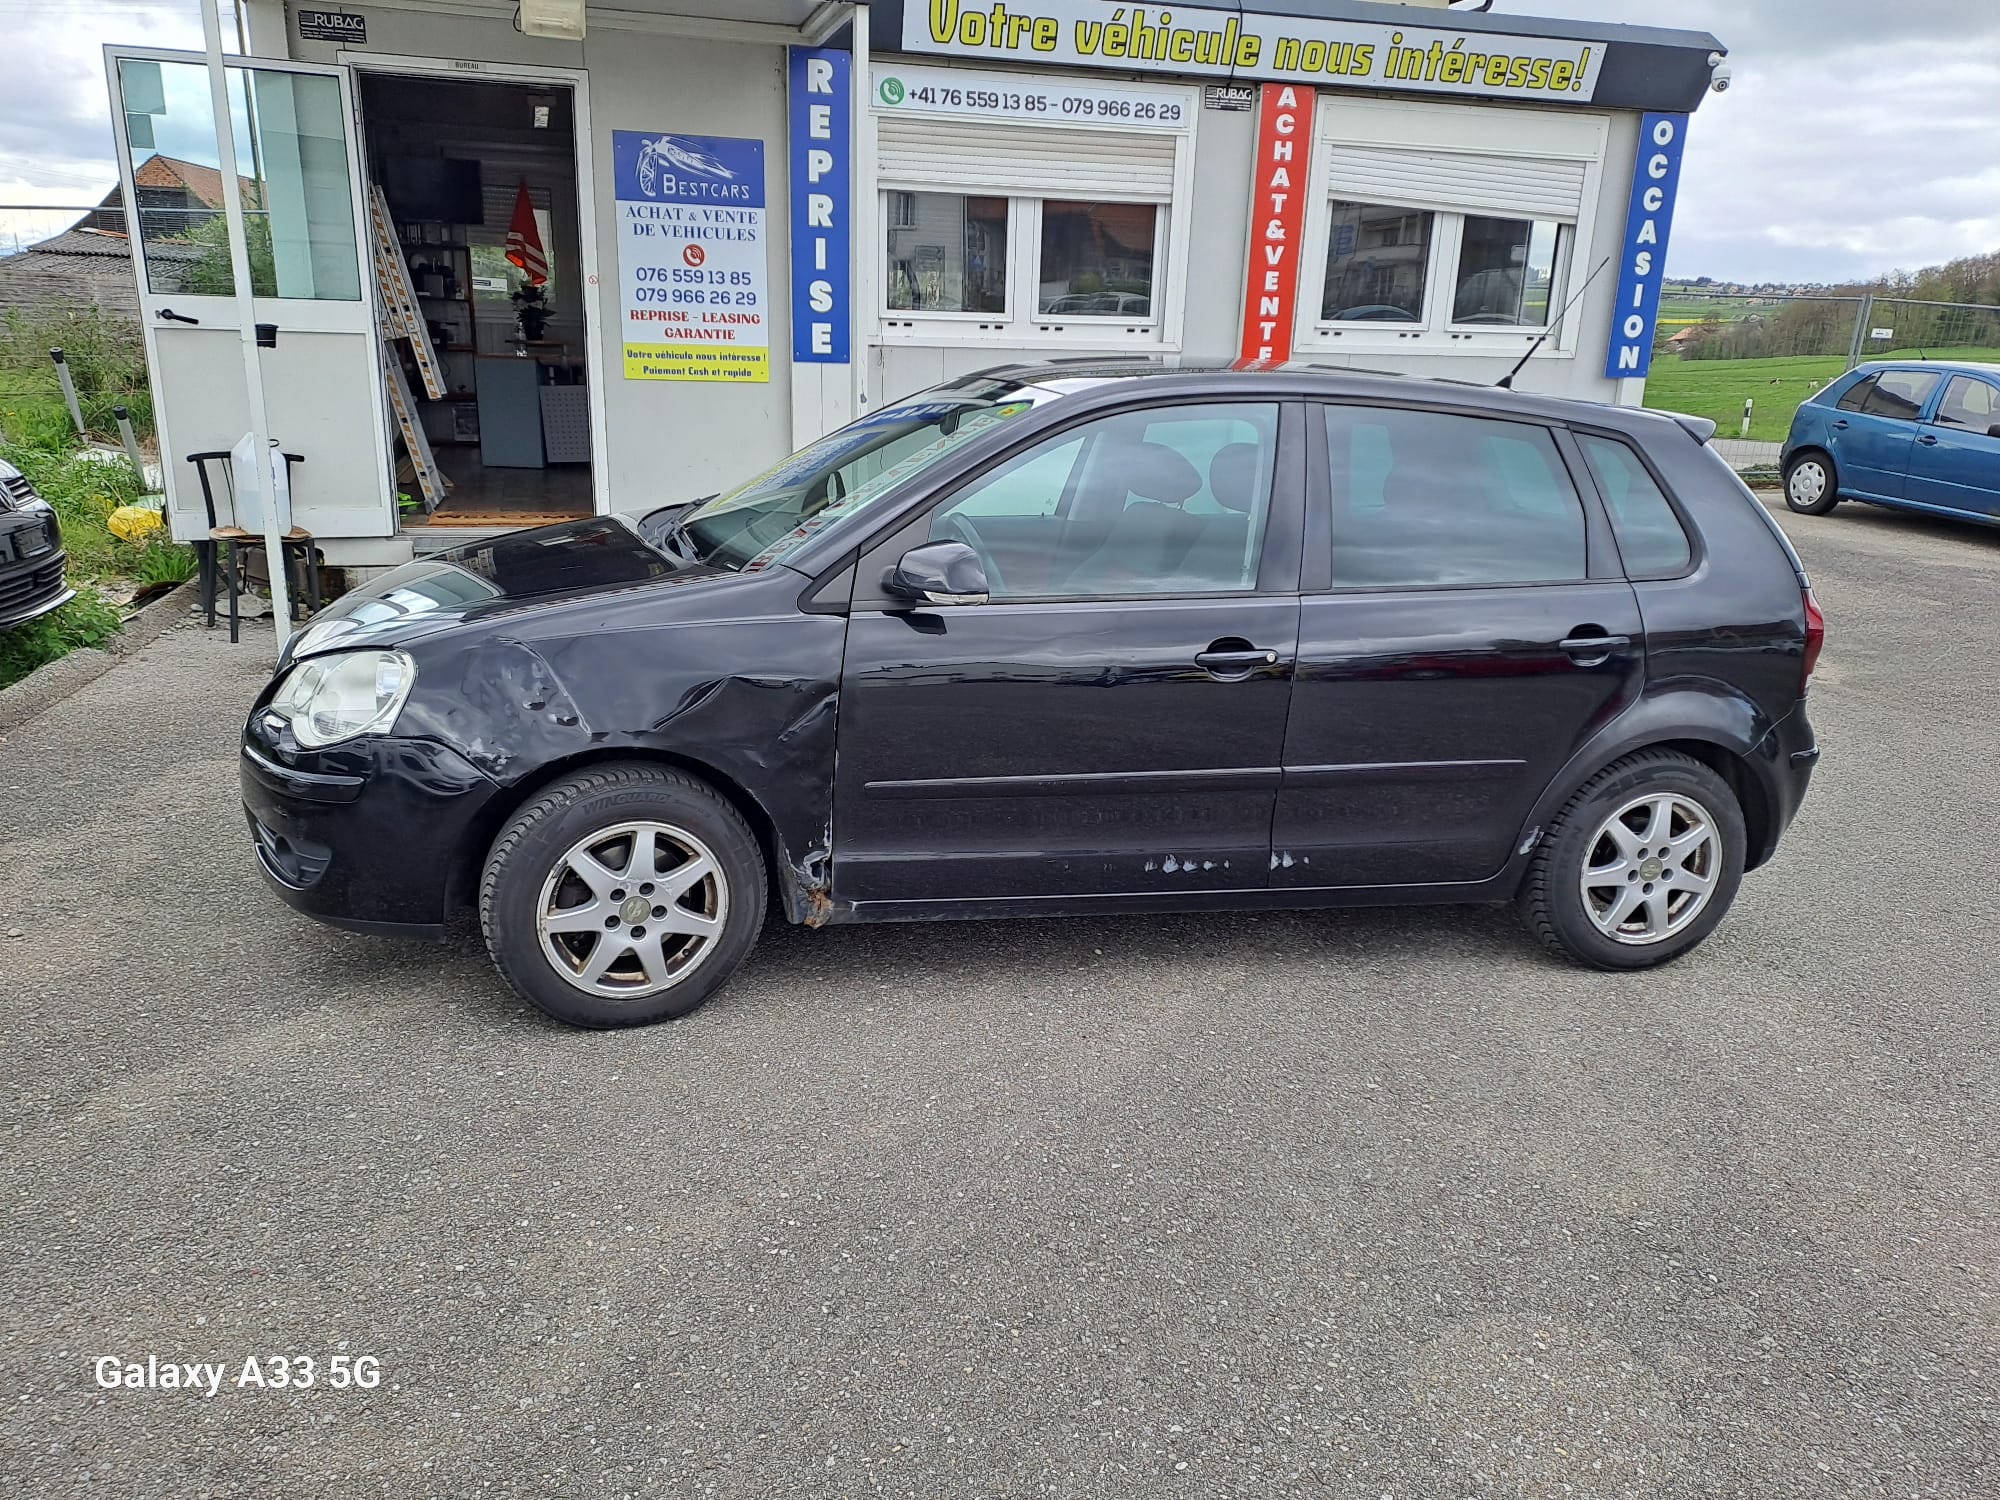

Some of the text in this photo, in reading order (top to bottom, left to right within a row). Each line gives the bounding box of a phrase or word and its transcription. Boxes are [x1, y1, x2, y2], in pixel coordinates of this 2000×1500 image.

[314, 14, 365, 29] RUBAG
[929, 0, 1590, 92] Votre véhicule nous intéresse!
[909, 87, 937, 104] +41
[940, 88, 962, 105] 76
[966, 90, 999, 109] 559
[1002, 93, 1021, 110] 13
[1024, 94, 1047, 112] 85
[1062, 97, 1093, 115] 079
[1097, 99, 1131, 117] 966
[1134, 102, 1156, 119] 26
[1159, 103, 1181, 120] 29
[1216, 88, 1252, 100] RUBAG
[663, 173, 750, 199] BESTCARS
[626, 205, 757, 224] ACHAT & VENTE
[807, 58, 834, 355] REPRISE
[633, 223, 756, 242] DE VEHICULES
[1618, 120, 1674, 369] OCCASION
[636, 267, 751, 286] 076 559 13 85
[636, 287, 757, 306] 079 966 26 29
[630, 310, 689, 322] REPRISE
[702, 312, 761, 324] LEASING
[664, 327, 736, 340] GARANTIE
[627, 349, 652, 359] Votre
[655, 350, 693, 360] véhicule
[696, 353, 717, 361] nous
[643, 365, 752, 378] Paiement Cash et rapide
